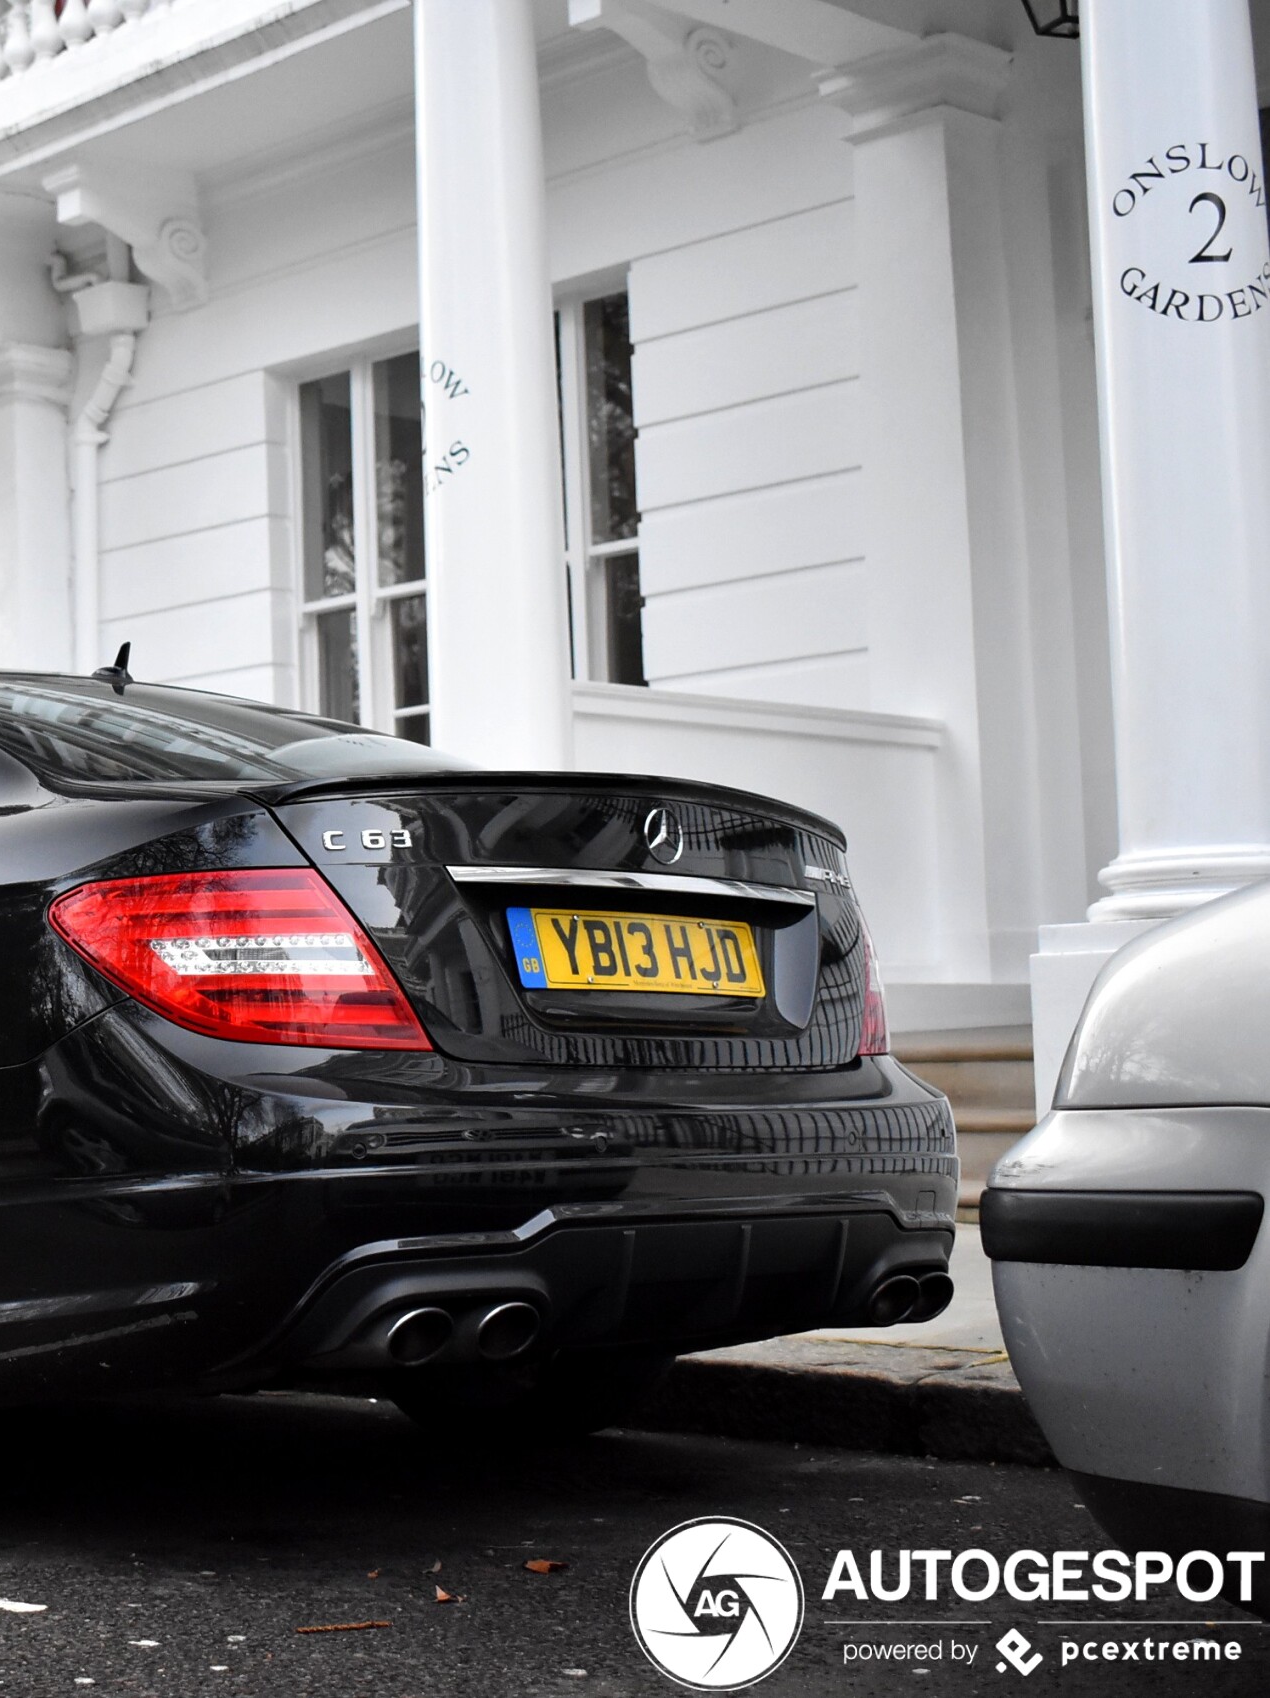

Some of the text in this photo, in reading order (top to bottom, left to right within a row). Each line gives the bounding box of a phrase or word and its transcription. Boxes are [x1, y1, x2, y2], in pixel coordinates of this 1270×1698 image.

[1188, 191, 1233, 263] 2
[322, 829, 413, 851] C 63
[522, 957, 540, 974] GB
[550, 918, 747, 983] YB13 HJD
